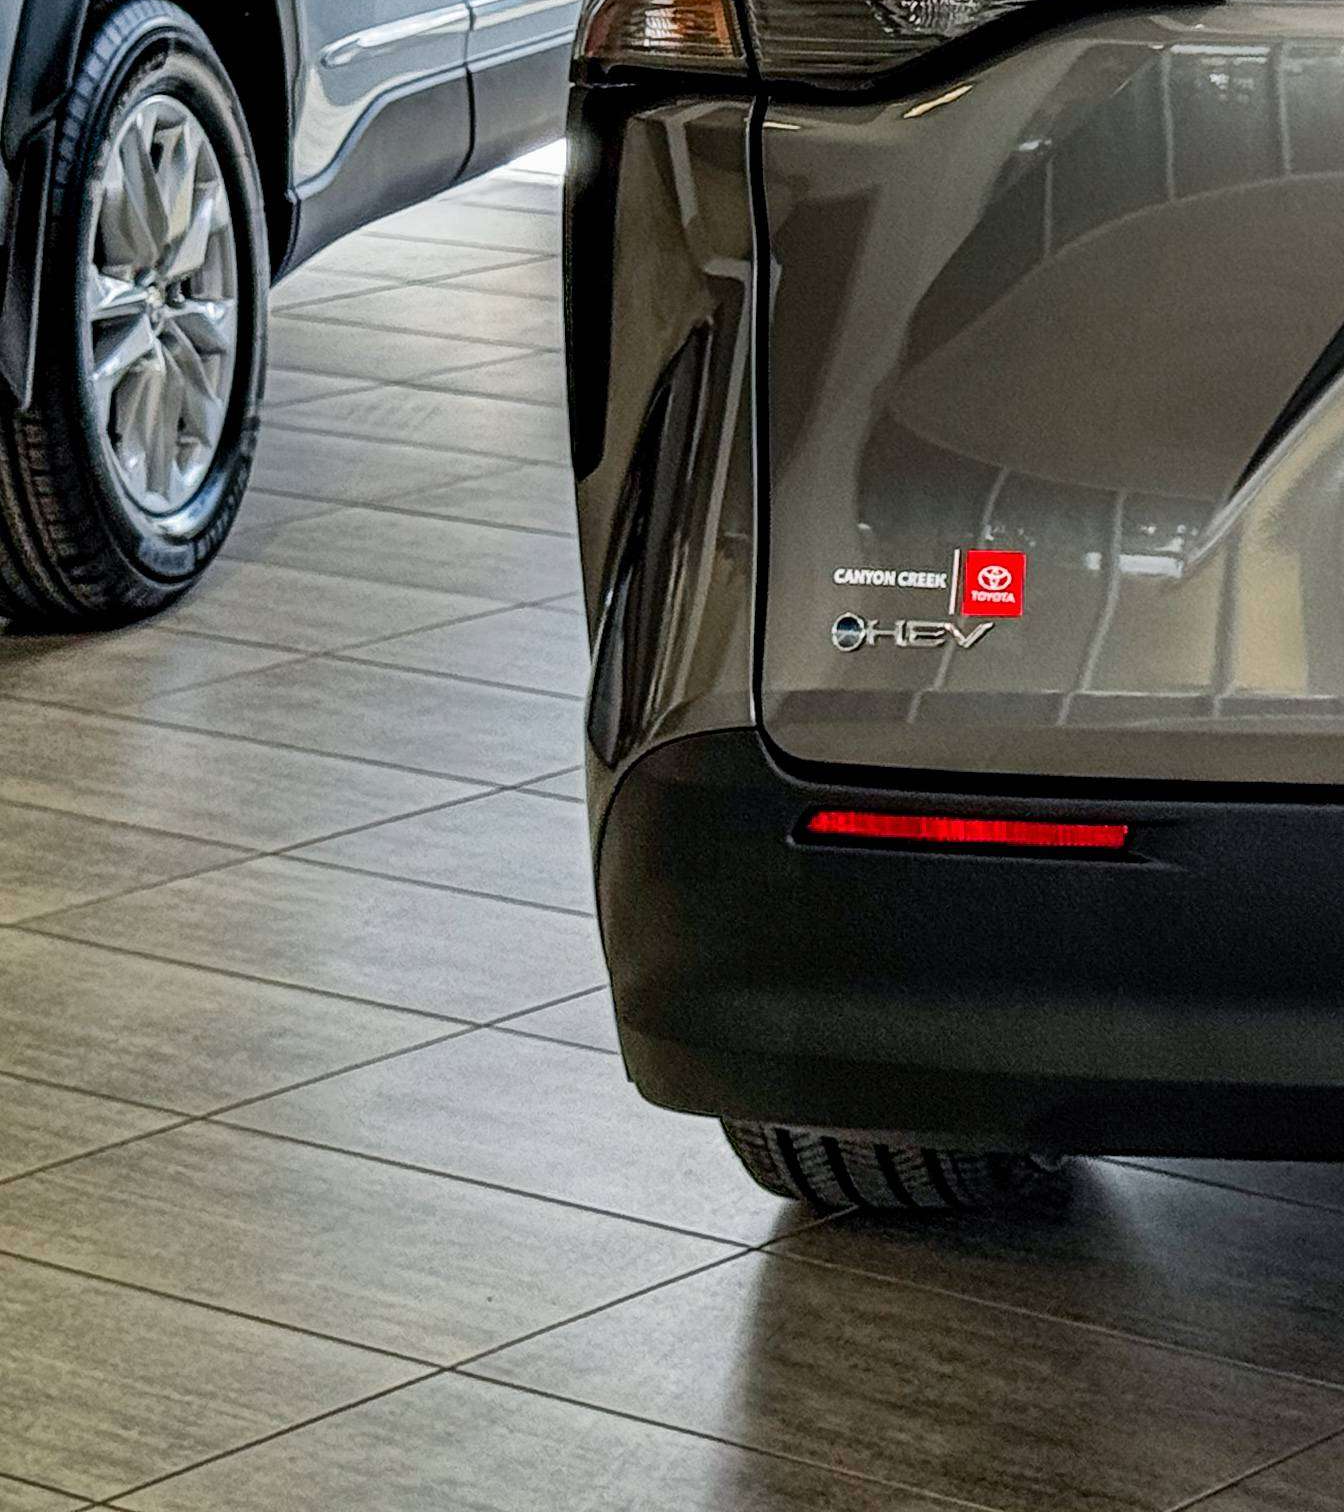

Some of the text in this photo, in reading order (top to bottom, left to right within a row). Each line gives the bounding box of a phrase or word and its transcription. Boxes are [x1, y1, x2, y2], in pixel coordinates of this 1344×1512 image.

[833, 568, 947, 589] CANYON CREEK
[971, 590, 1016, 604] TOYOTA
